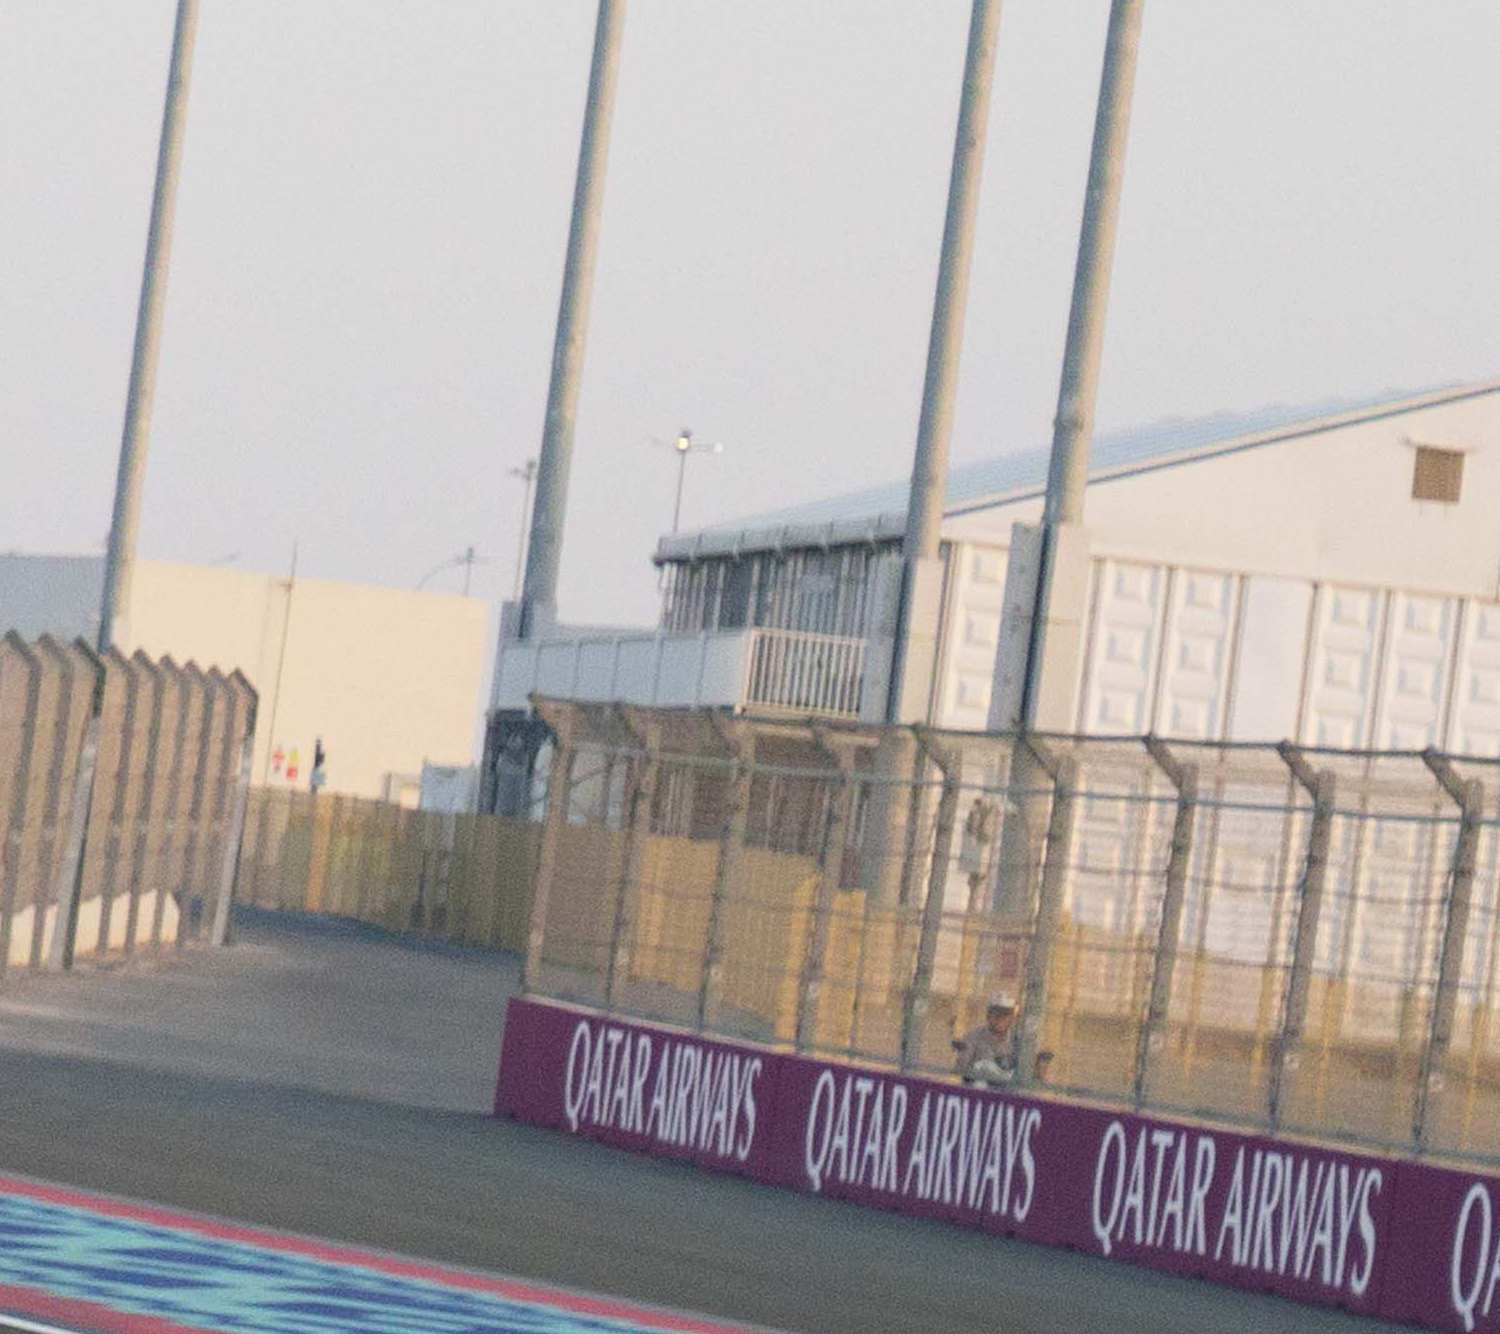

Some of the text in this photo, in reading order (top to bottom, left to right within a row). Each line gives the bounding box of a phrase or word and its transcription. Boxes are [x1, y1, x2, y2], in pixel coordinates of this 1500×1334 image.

[563, 1021, 763, 1162] QATAR AIRWAYS
[805, 1069, 1041, 1222] QATAR AIRWAYS
[1092, 1120, 1383, 1296] QATAR AIRWAYS
